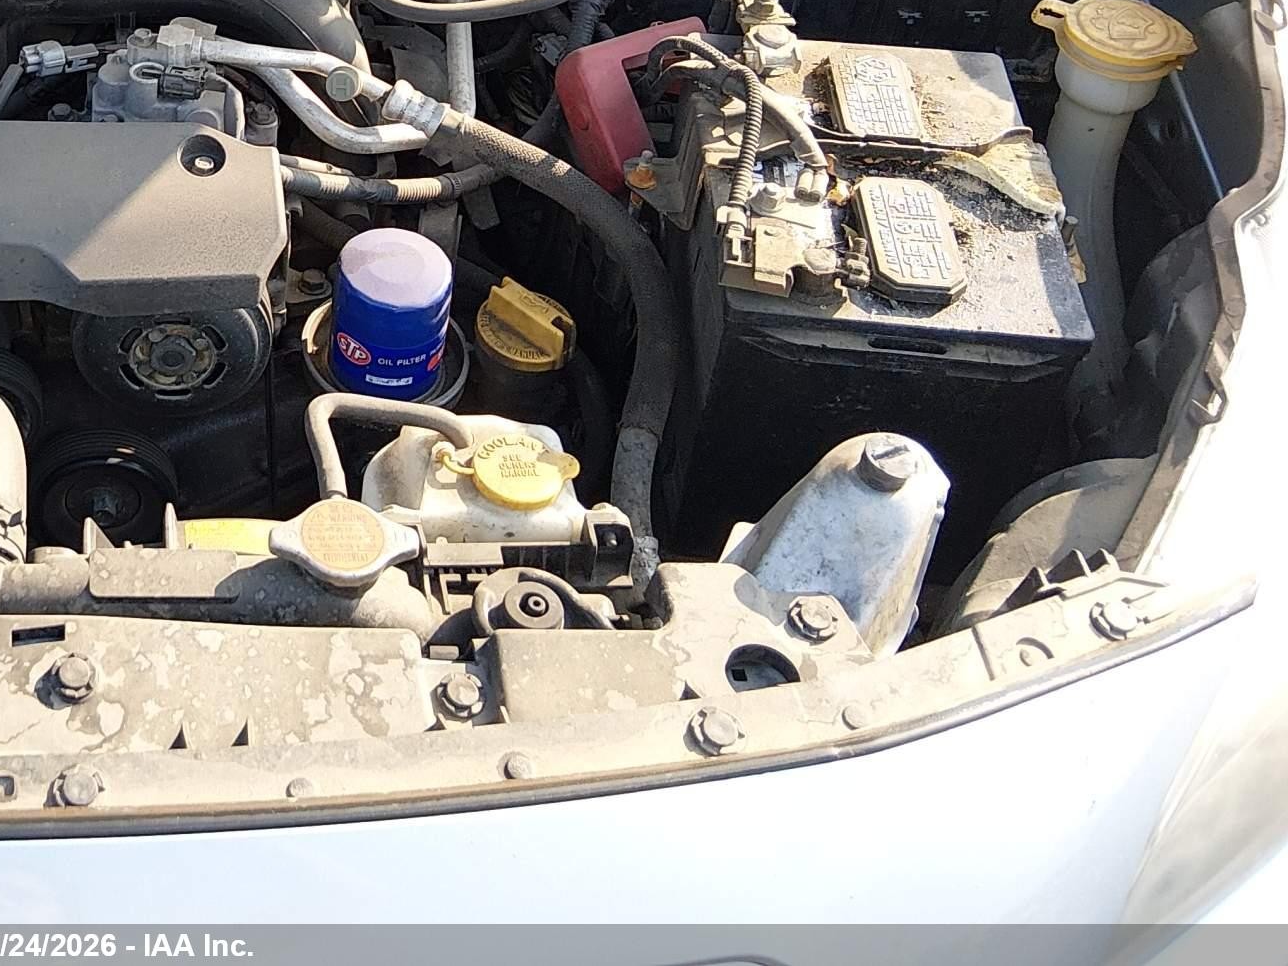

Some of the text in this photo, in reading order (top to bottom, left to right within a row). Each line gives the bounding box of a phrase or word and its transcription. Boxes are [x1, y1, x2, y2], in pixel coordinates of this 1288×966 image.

[338, 336, 366, 361] STP
[377, 353, 427, 366] OIL FILTER
